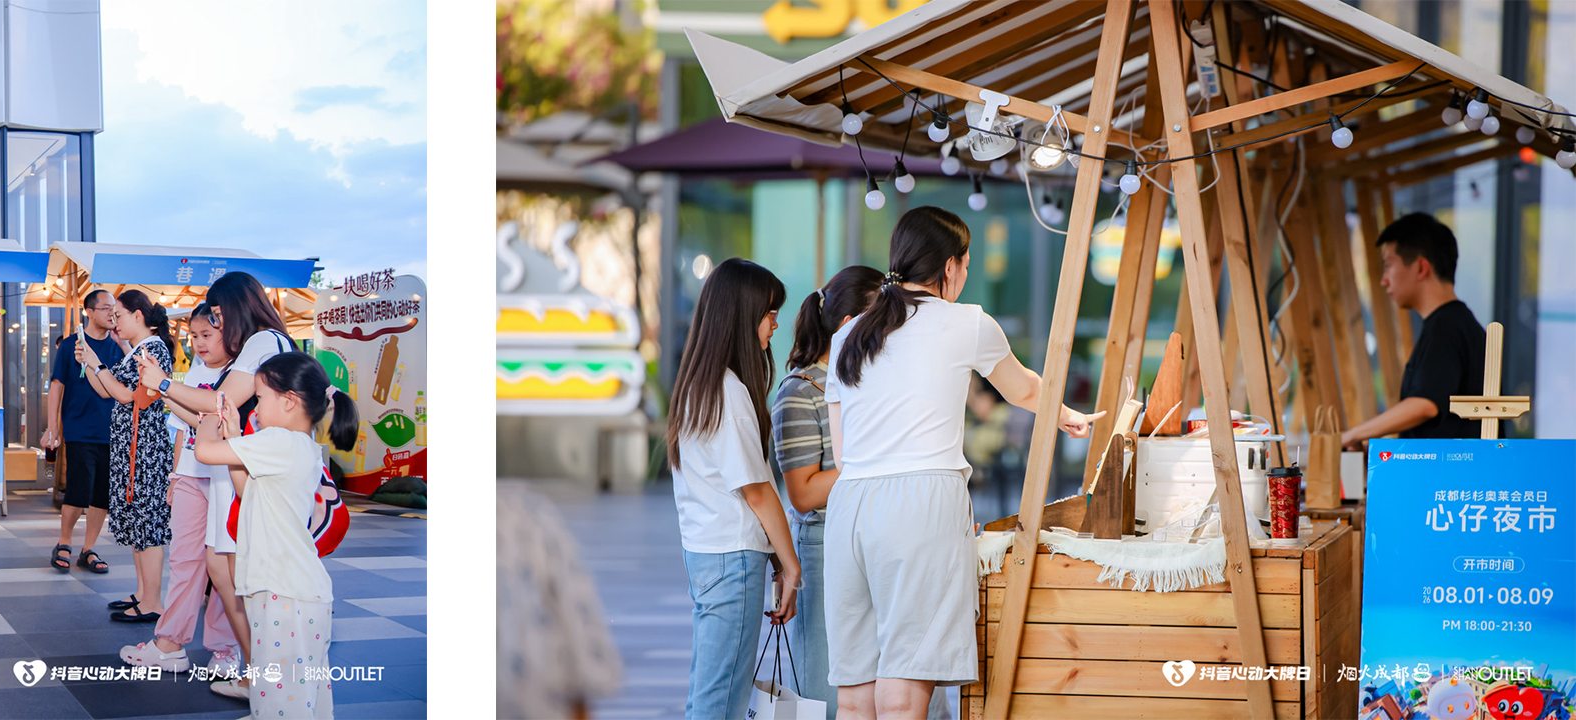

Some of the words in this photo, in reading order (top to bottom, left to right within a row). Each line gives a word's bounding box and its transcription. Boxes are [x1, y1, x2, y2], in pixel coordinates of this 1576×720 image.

[333, 267, 396, 297] 一块喝好茶
[1434, 490, 1547, 502] 成都杉杉奥莱会员日
[1425, 503, 1557, 533] 心仔夜市
[1463, 558, 1514, 571] 开市时间
[1422, 586, 1431, 595] 20
[1432, 586, 1484, 604] 08.01
[1497, 587, 1554, 605] 08.09
[1422, 596, 1431, 604] 26
[1442, 620, 1461, 630] PM
[1464, 620, 1532, 632] 18:00-21:30
